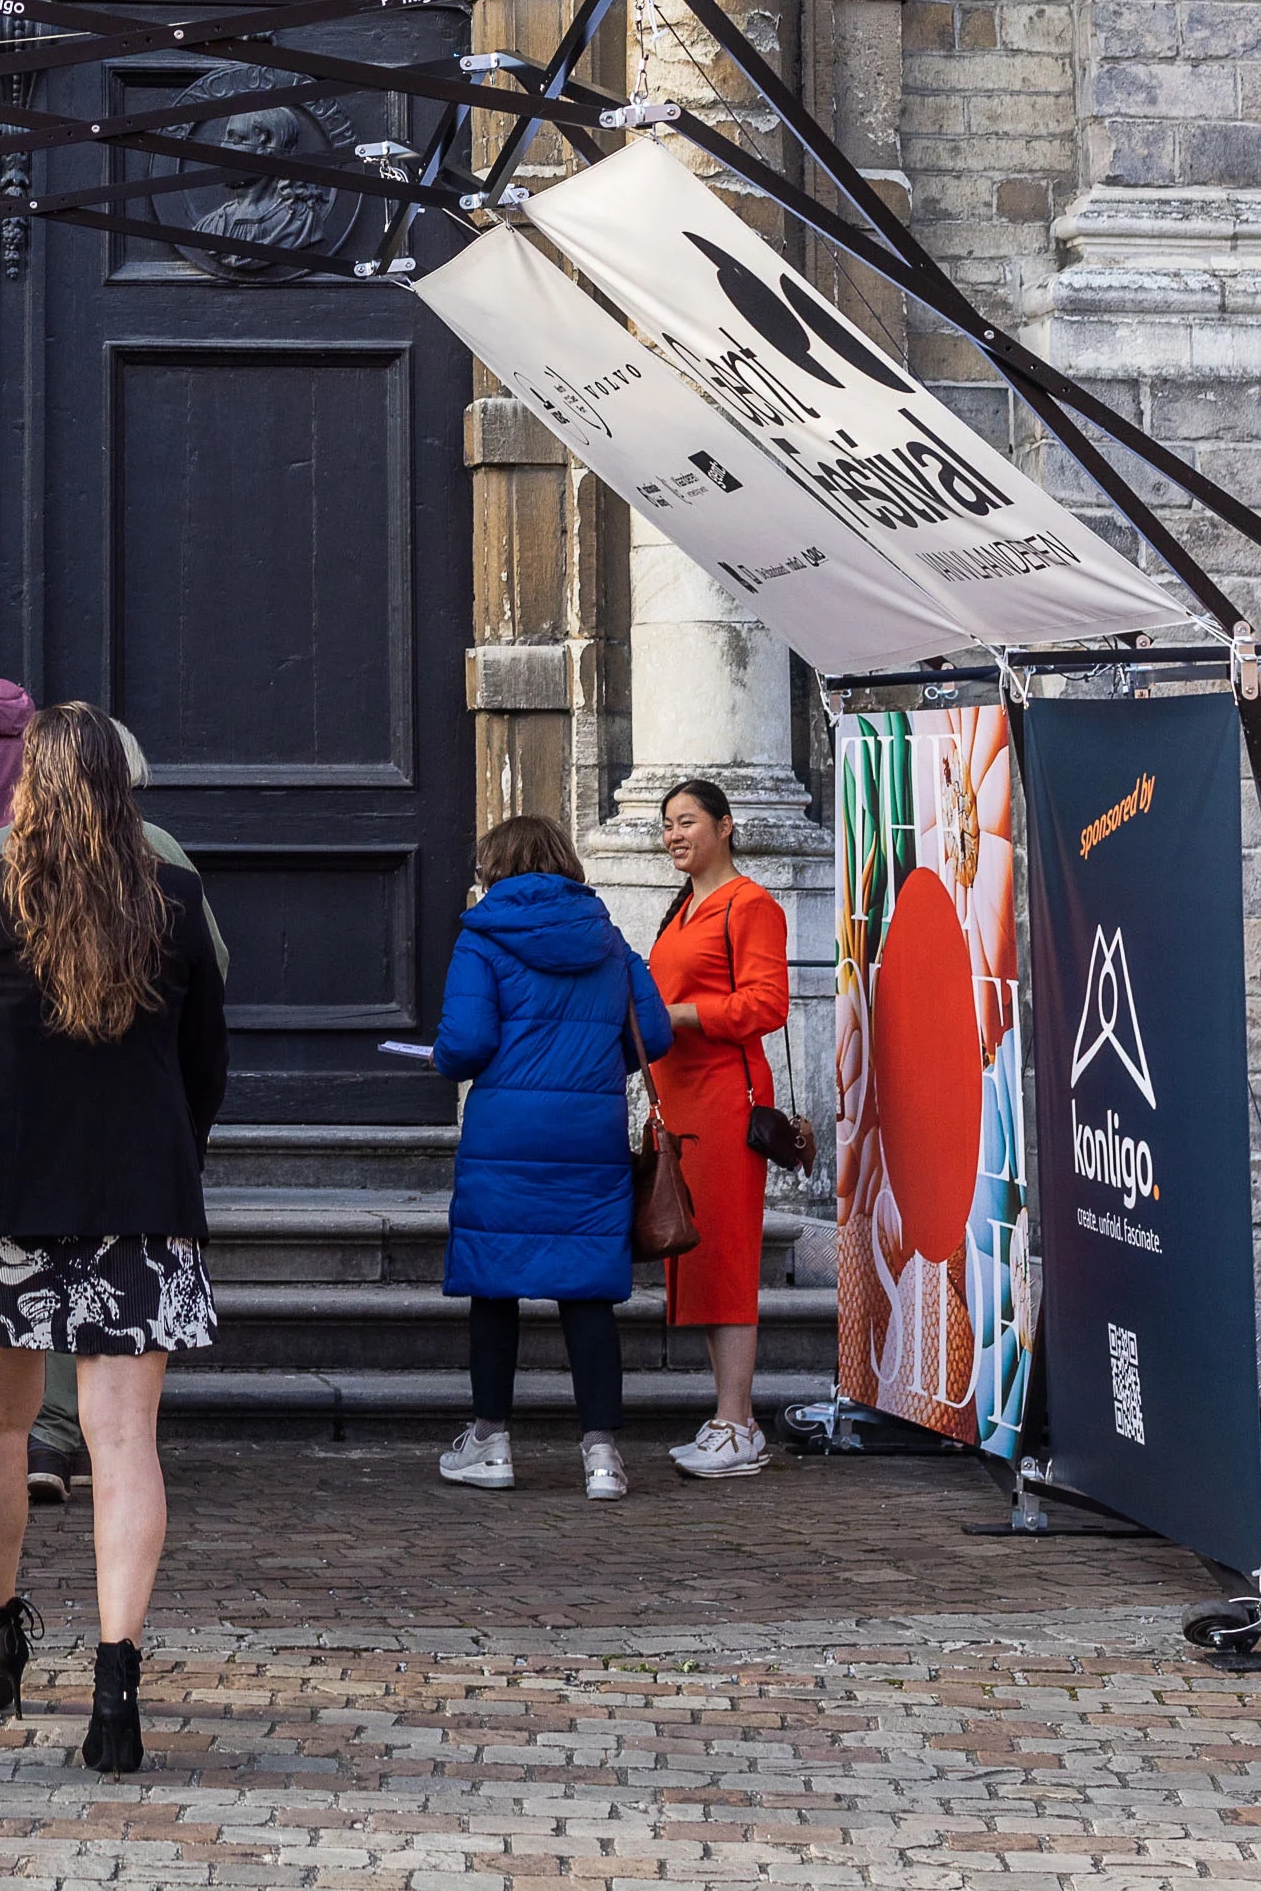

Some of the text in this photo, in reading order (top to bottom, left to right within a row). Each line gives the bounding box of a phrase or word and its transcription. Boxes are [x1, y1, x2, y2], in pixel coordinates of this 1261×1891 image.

[583, 363, 642, 400] VOLVO
[662, 326, 821, 427] Gent
[770, 407, 1015, 531] Festival
[1080, 772, 1156, 861] sponsored by
[1077, 1207, 1163, 1254] create. unfold. fascinate.
[870, 1189, 1023, 1433] SIDE
